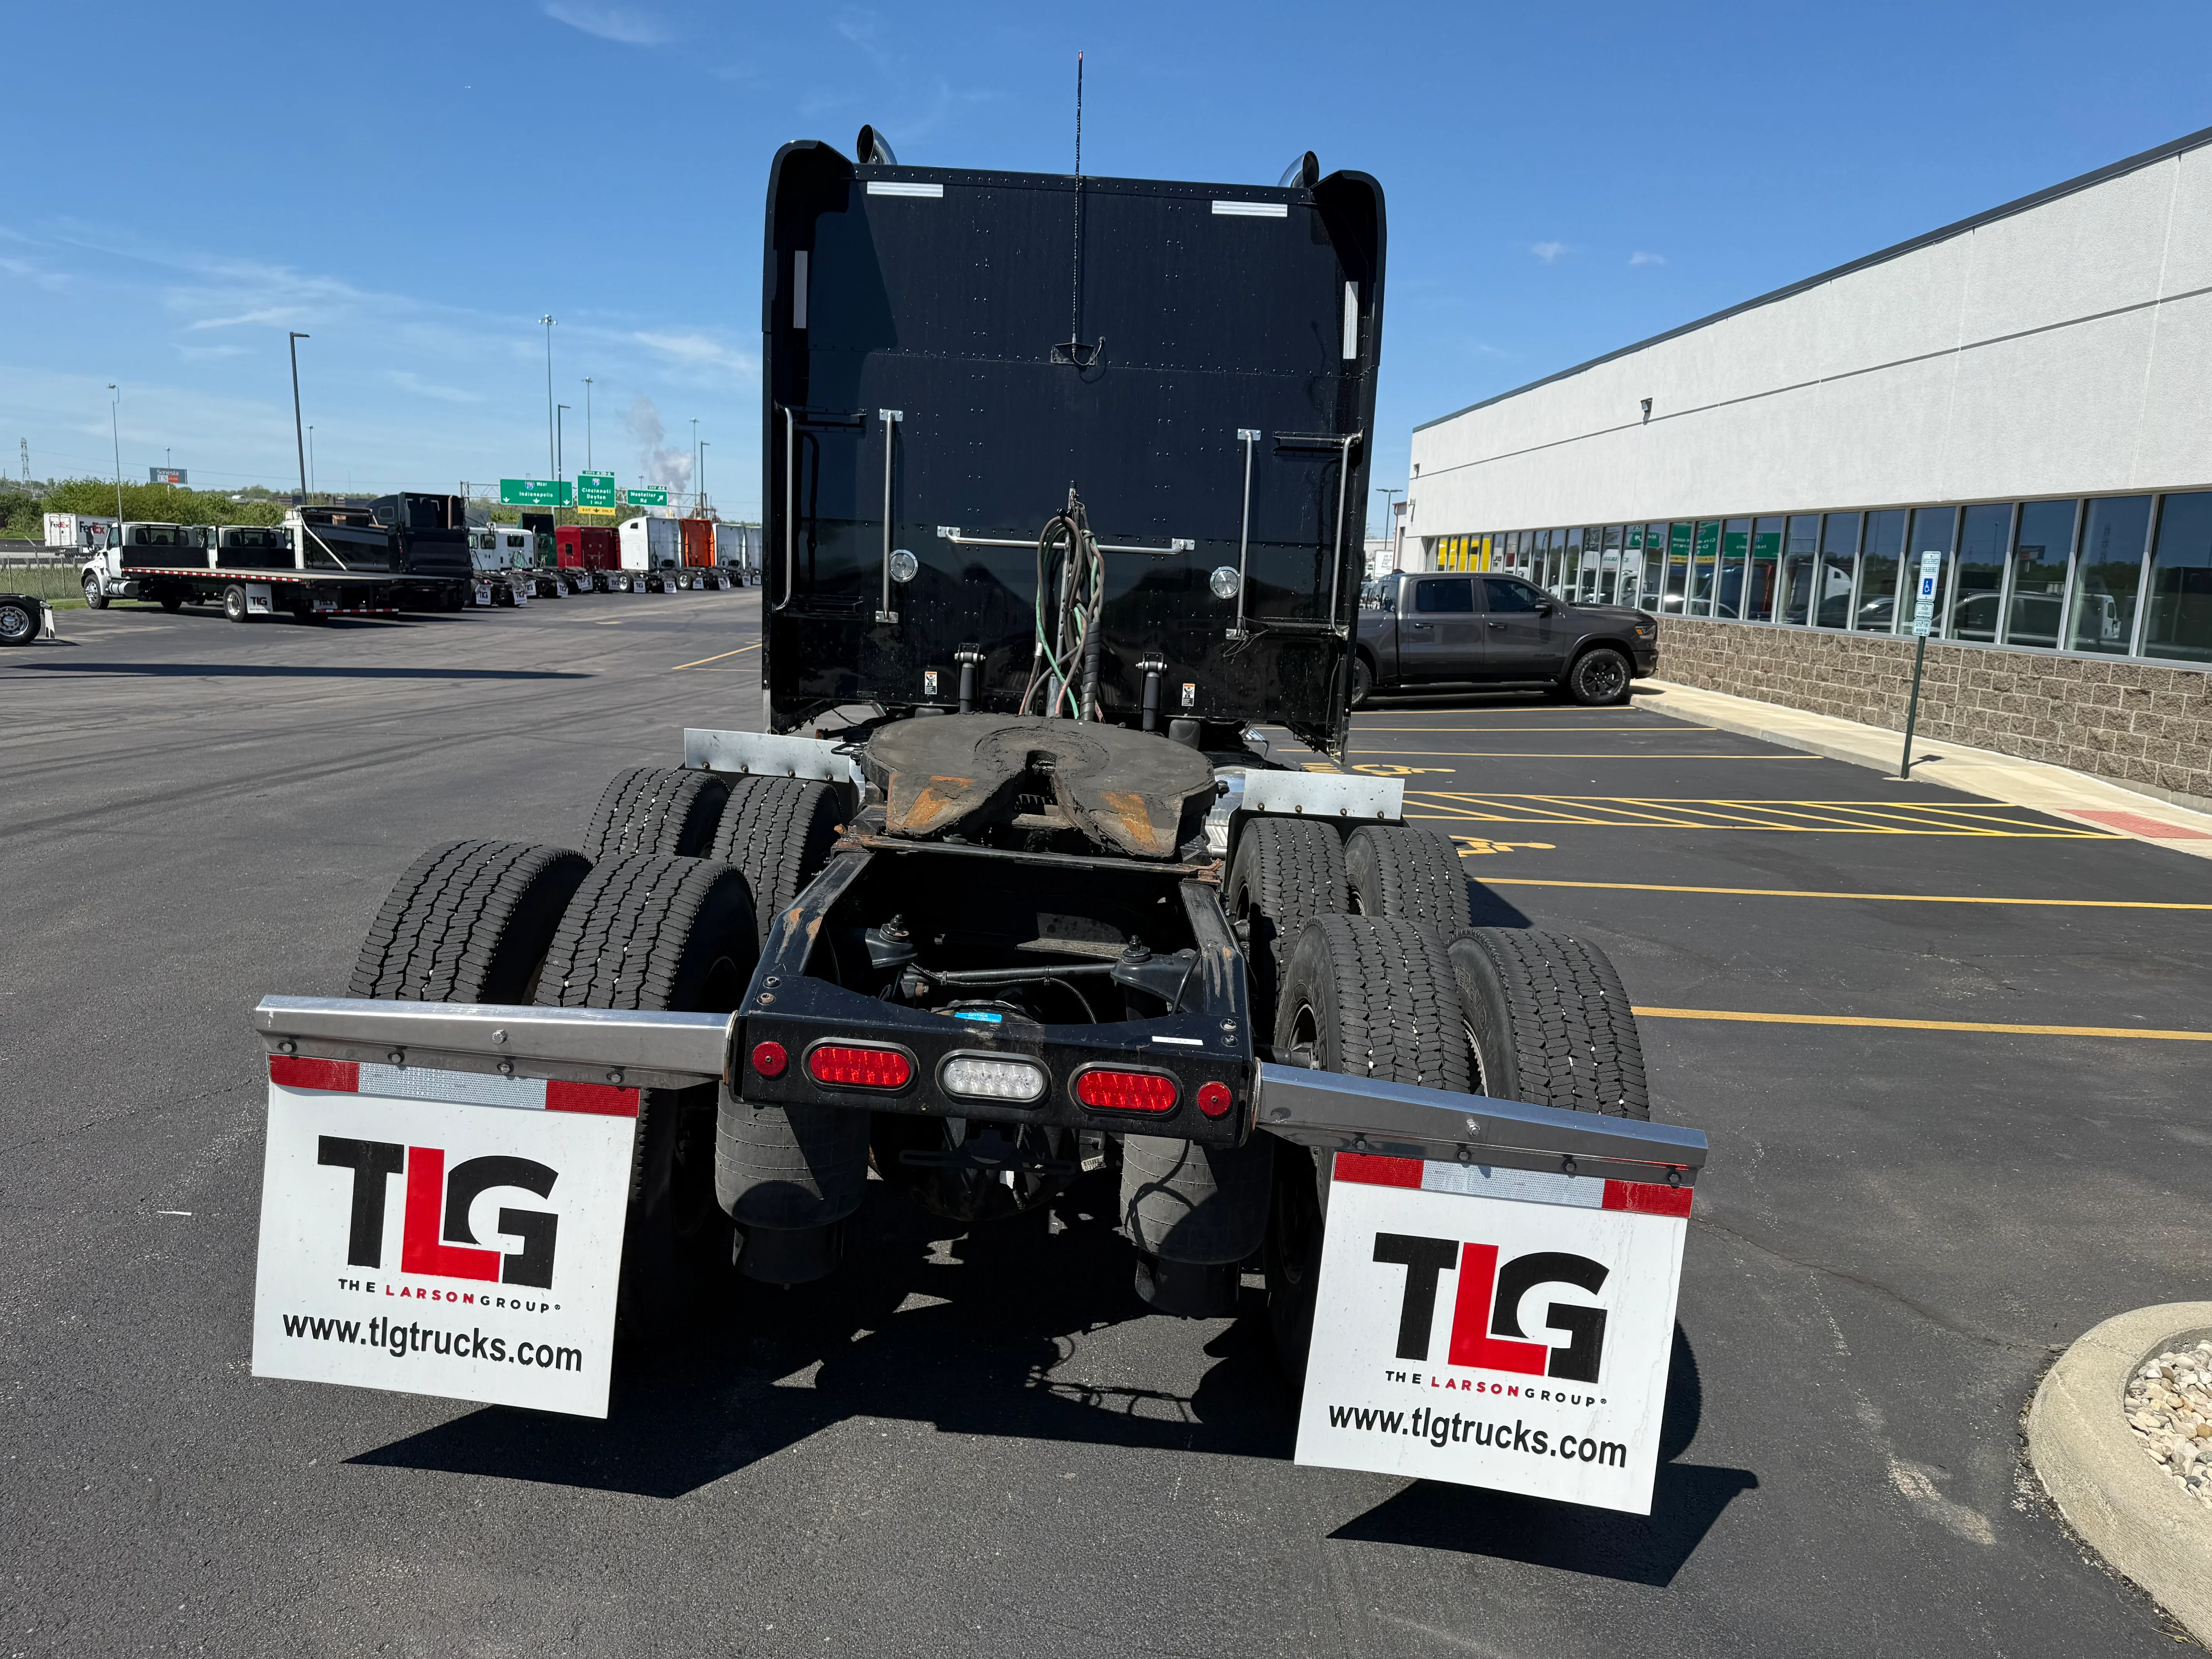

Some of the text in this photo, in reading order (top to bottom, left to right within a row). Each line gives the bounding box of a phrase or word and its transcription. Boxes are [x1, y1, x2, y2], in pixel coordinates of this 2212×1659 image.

[250, 596, 268, 606] TLG
[317, 1135, 559, 1290] TLG
[338, 1279, 376, 1294] THE
[1373, 1232, 1609, 1384] TLG
[283, 1313, 582, 1372] www.tlgtrucks.com
[1385, 1370, 1421, 1385] THE
[1329, 1405, 1626, 1468] www.tlgtrucks.com
